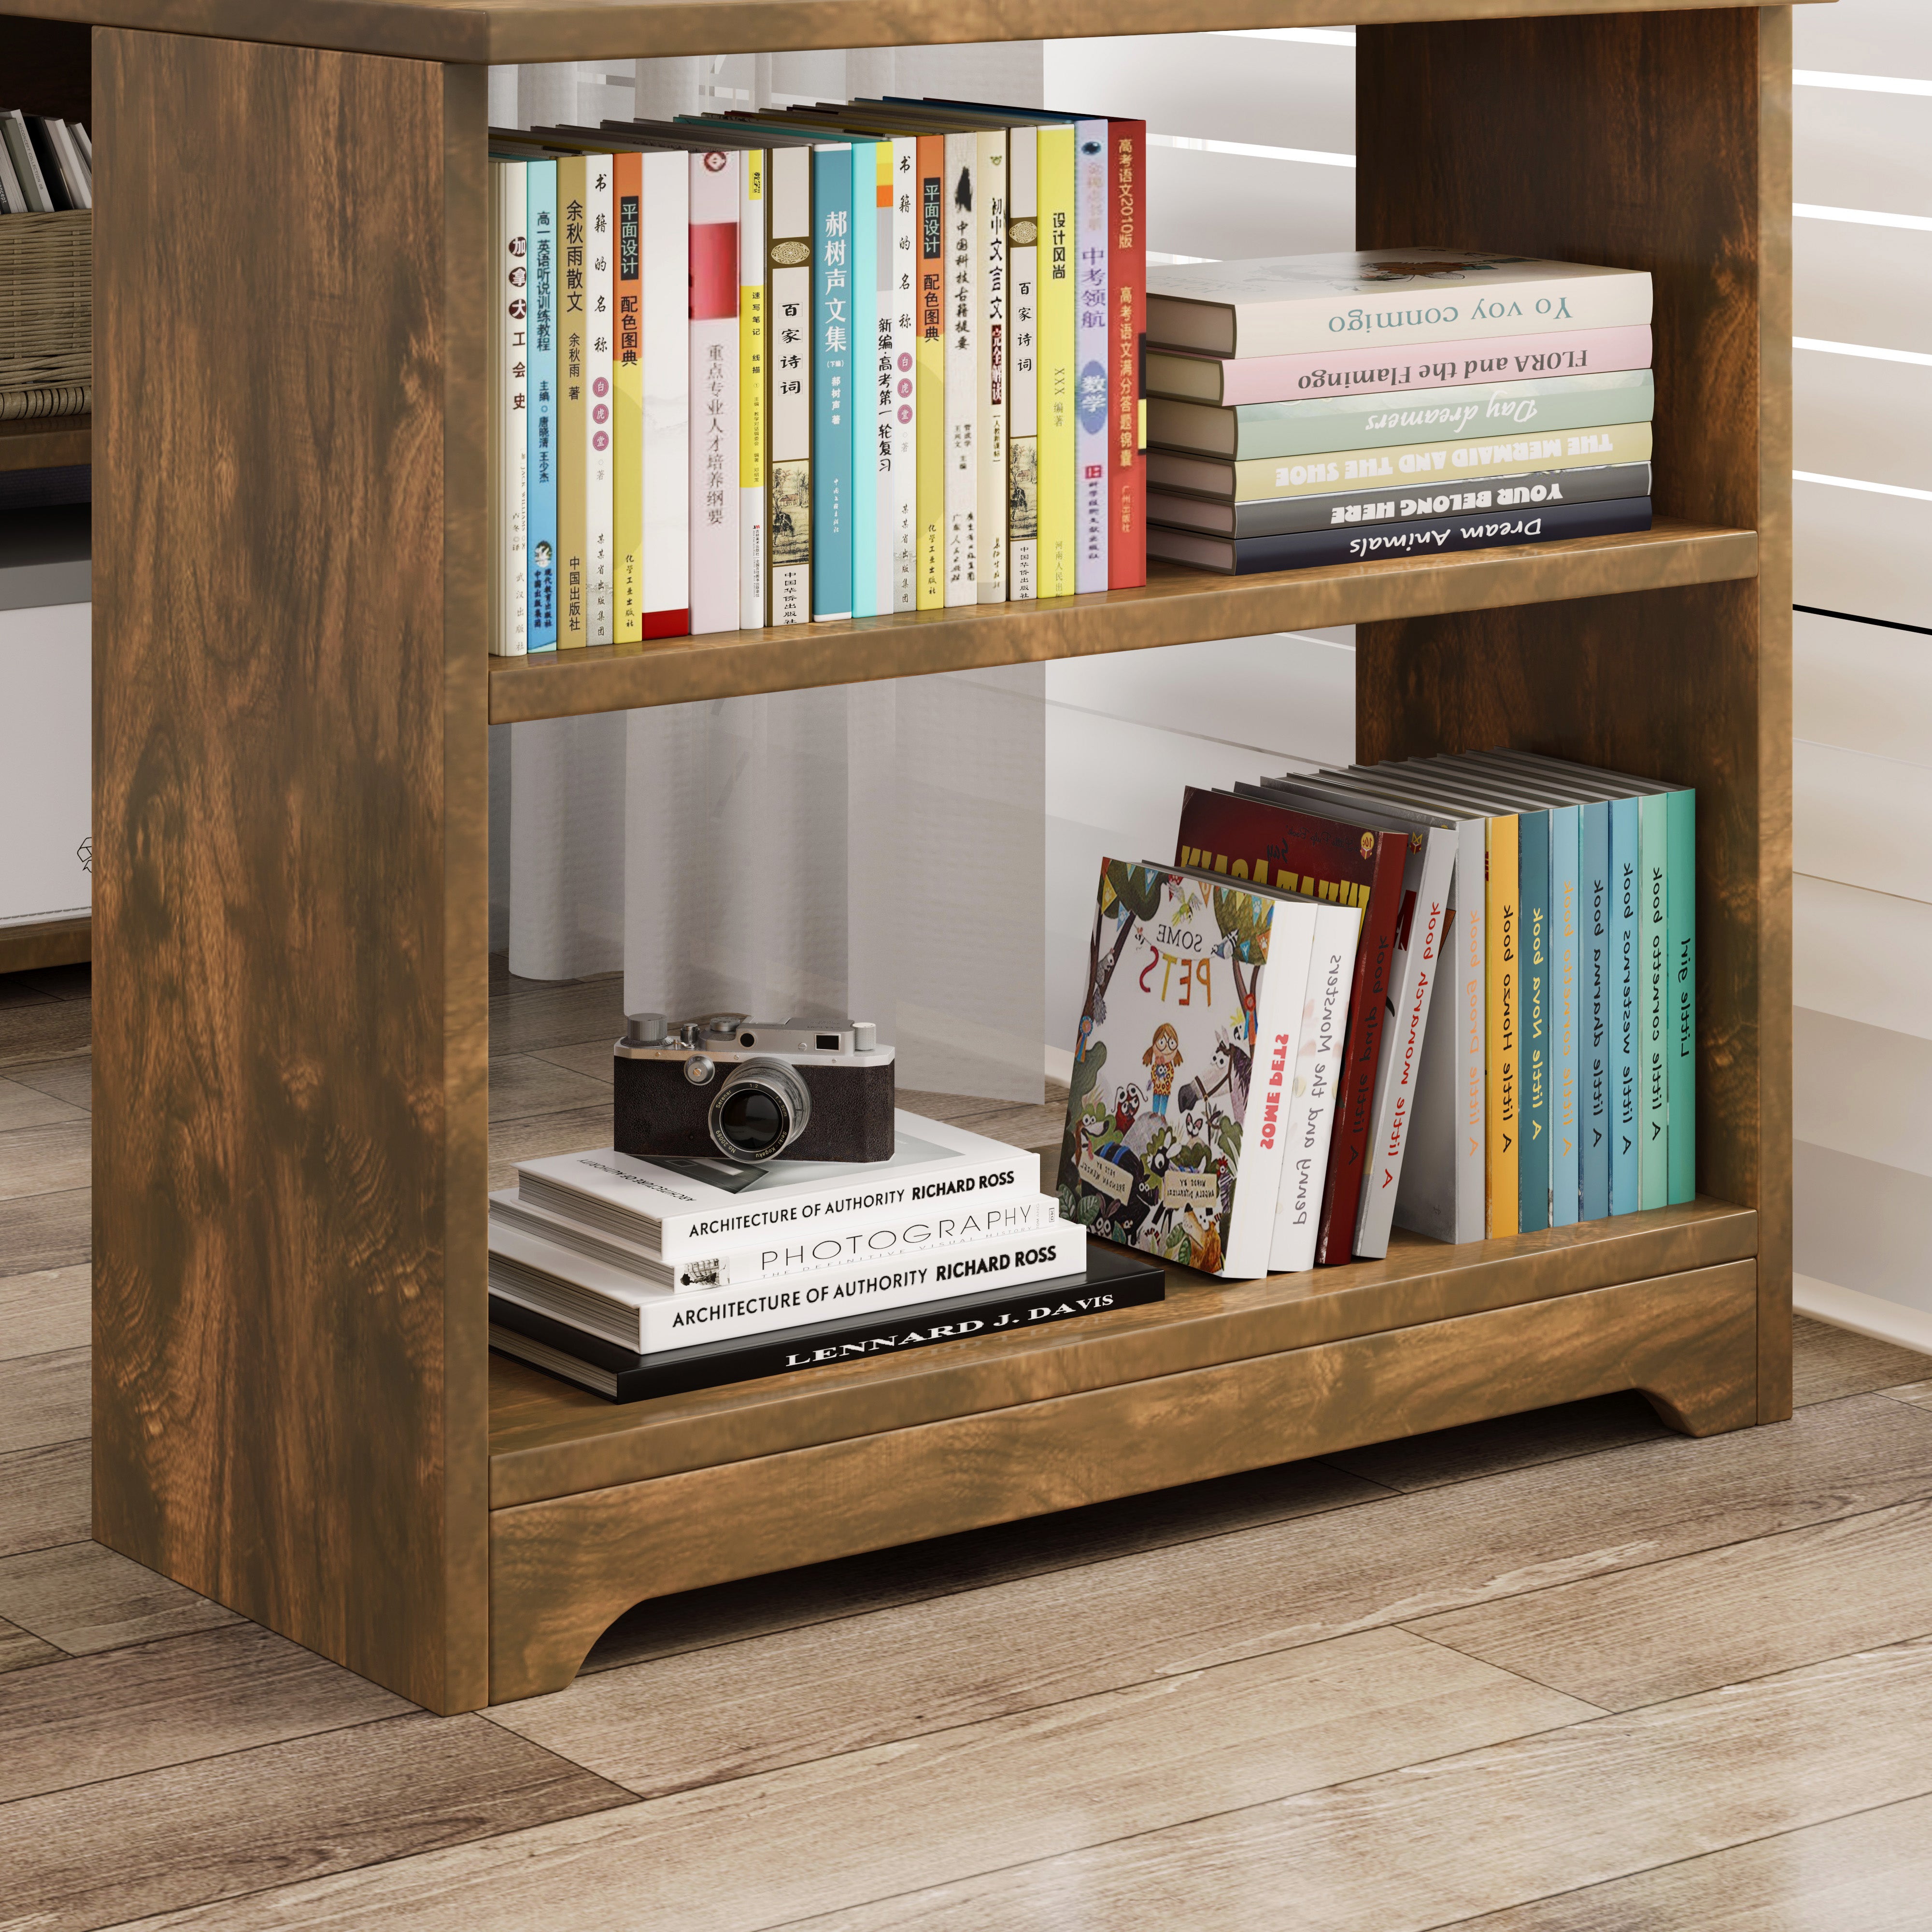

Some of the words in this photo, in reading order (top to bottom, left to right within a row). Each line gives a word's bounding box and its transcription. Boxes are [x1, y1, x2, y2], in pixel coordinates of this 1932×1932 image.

[18, 123, 30, 151] BOCONCEPT
[28, 153, 41, 182] COLLECTION
[1119, 139, 1133, 248] 高考语文2010版
[621, 203, 638, 275] 平面设计
[923, 185, 940, 253] 平面设计
[567, 199, 583, 312] 余秋雨散文
[595, 174, 608, 353] 书籍的名称
[899, 156, 911, 329] 书籍的名称
[1052, 212, 1065, 279] 设计风尚
[537, 211, 551, 352] 高一英语听说训练教程
[824, 211, 847, 353] 郝树声文集
[1081, 247, 1106, 328] 中考领航
[511, 238, 526, 410] 加拿大工会史
[752, 292, 760, 336] 速写笔记
[923, 274, 940, 342] 配色图典
[1017, 282, 1033, 372] 百家诗词
[1329, 307, 1458, 333] conmigo
[1471, 298, 1523, 319] voy
[1536, 298, 1573, 319] Yo
[621, 296, 638, 367] 配色图典
[780, 303, 801, 395] 百家诗词
[569, 333, 580, 377] 余秋雨
[752, 355, 760, 374] 线描
[1419, 363, 1457, 380] the
[1464, 357, 1507, 379] and
[1514, 350, 1587, 372] FLORA
[569, 386, 580, 400] 著
[831, 376, 841, 411] 郝树声
[878, 317, 893, 472] 新编·高考第一轮复习
[899, 354, 910, 422] 白虎堂
[1082, 375, 1106, 412] 数学
[1298, 367, 1411, 388] Flamingo
[595, 380, 607, 449] 白虎堂
[831, 414, 841, 426] 著
[1053, 402, 1063, 426] 编著
[1364, 404, 1478, 432] dreamers
[1487, 389, 1536, 422] Day
[707, 345, 725, 526] 重点专业人才培养纲要
[1451, 439, 1562, 468] MERMAID
[1567, 434, 1613, 454] THE
[1274, 468, 1341, 489] SHOE
[1345, 456, 1393, 479] THE
[1399, 451, 1444, 472] AND
[1329, 502, 1397, 526] HERE
[1400, 491, 1493, 519] BELONG
[1497, 483, 1565, 507] YOUR
[1350, 529, 1450, 555] Animals
[1461, 518, 1541, 538] Dream
[901, 504, 909, 604] 某某省出版集团
[1020, 546, 1030, 598] 中国华侨出版社
[569, 556, 580, 631] 中国出版社
[596, 534, 605, 636] 某某省出版集团
[783, 572, 797, 624] 中国华侨出版社
[516, 572, 525, 651] 武汉出版社
[716, 1090, 732, 1108] Serenar
[755, 1147, 776, 1158] Kogaku
[778, 1131, 787, 1145] Seiki
[577, 1159, 626, 1175] AUTHORITY
[632, 1179, 696, 1201] ARCHITECTURE
[689, 1208, 797, 1237] ARCHITECTURE
[802, 1204, 821, 1217] OF
[825, 1190, 904, 1214] AUTHORITY
[912, 1178, 975, 1200] RICHARD
[980, 1171, 1014, 1189] ROSS
[761, 1205, 1031, 1270] PHOTOGRAPHY
[803, 1249, 906, 1271] DEFINITIVE
[919, 1236, 973, 1250] VISUAL
[986, 1226, 1032, 1237] HISTORY
[673, 1291, 803, 1330] ARCHITECTURE
[807, 1286, 828, 1303] OF
[833, 1269, 927, 1298] AUTHORITY
[937, 1254, 1010, 1281] RICHARD
[1015, 1246, 1056, 1267] ROSS
[783, 1319, 986, 1368] LENNARD
[994, 1314, 1019, 1326] J.
[1028, 1294, 1116, 1322] DAVIS
